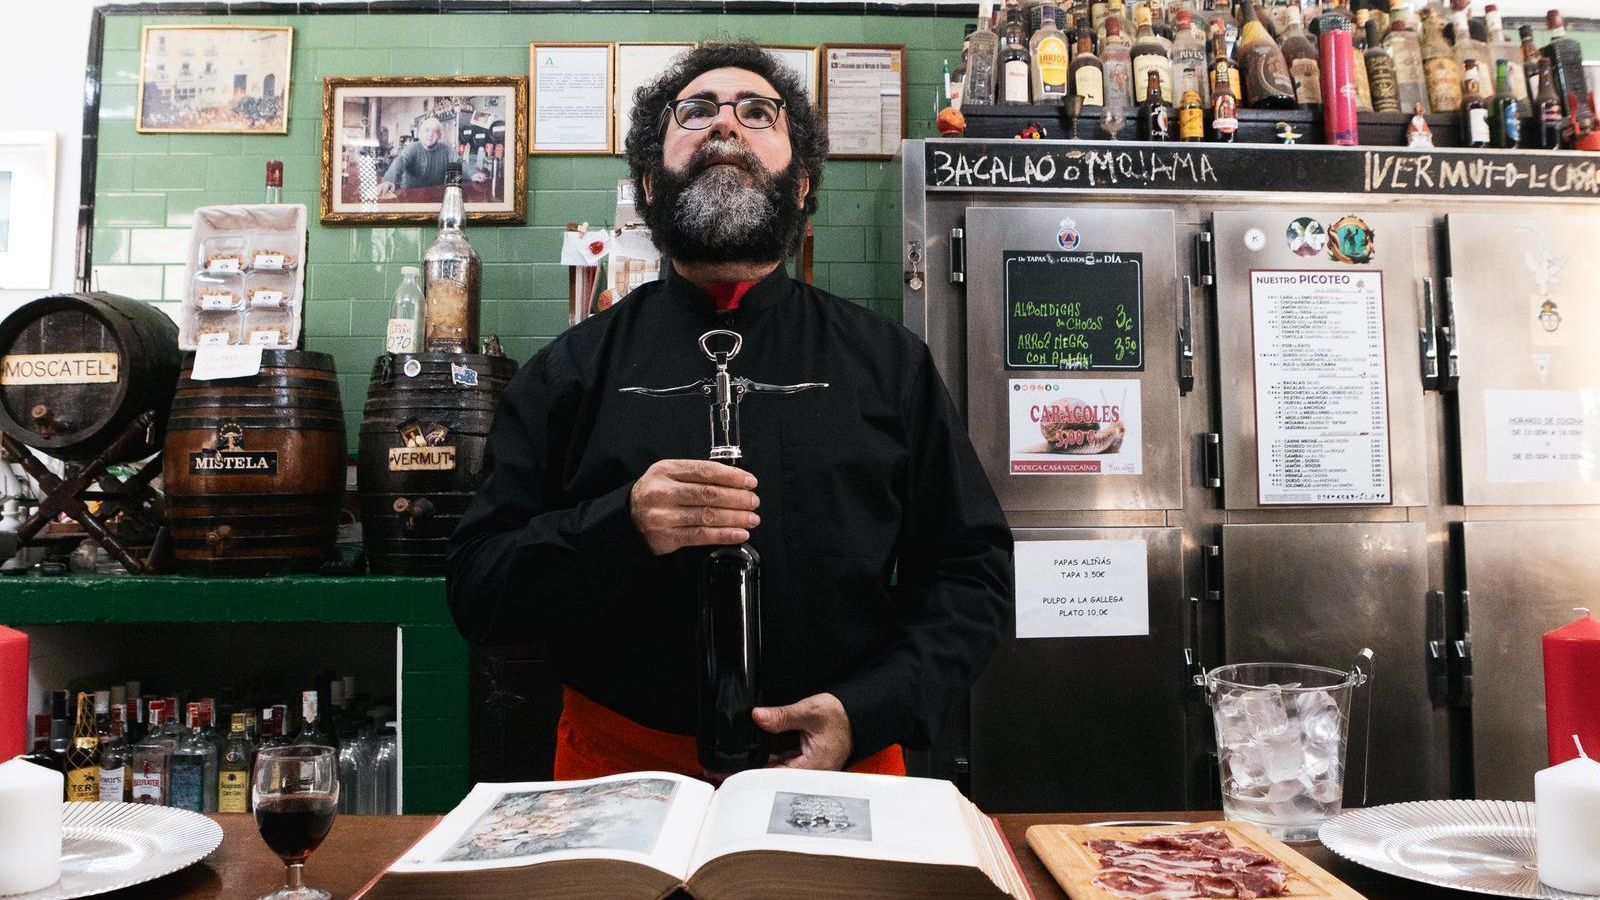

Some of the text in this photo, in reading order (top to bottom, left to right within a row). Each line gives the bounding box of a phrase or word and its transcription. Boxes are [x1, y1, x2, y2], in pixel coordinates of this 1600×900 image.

[1180, 50, 1204, 60] RIVES
[934, 151, 1056, 186] BACALAO
[1104, 254, 1122, 263] DÍA
[1299, 275, 1350, 284] PICOTEO
[1066, 316, 1104, 330] CHOCOS
[1054, 334, 1089, 349] NEGRO
[5, 358, 110, 378] MOSCATEL
[1030, 405, 1120, 423] CARACOLES
[195, 456, 269, 470] MISTELA
[393, 453, 450, 465] VERMUT
[133, 778, 160, 787] BEEFEATER
